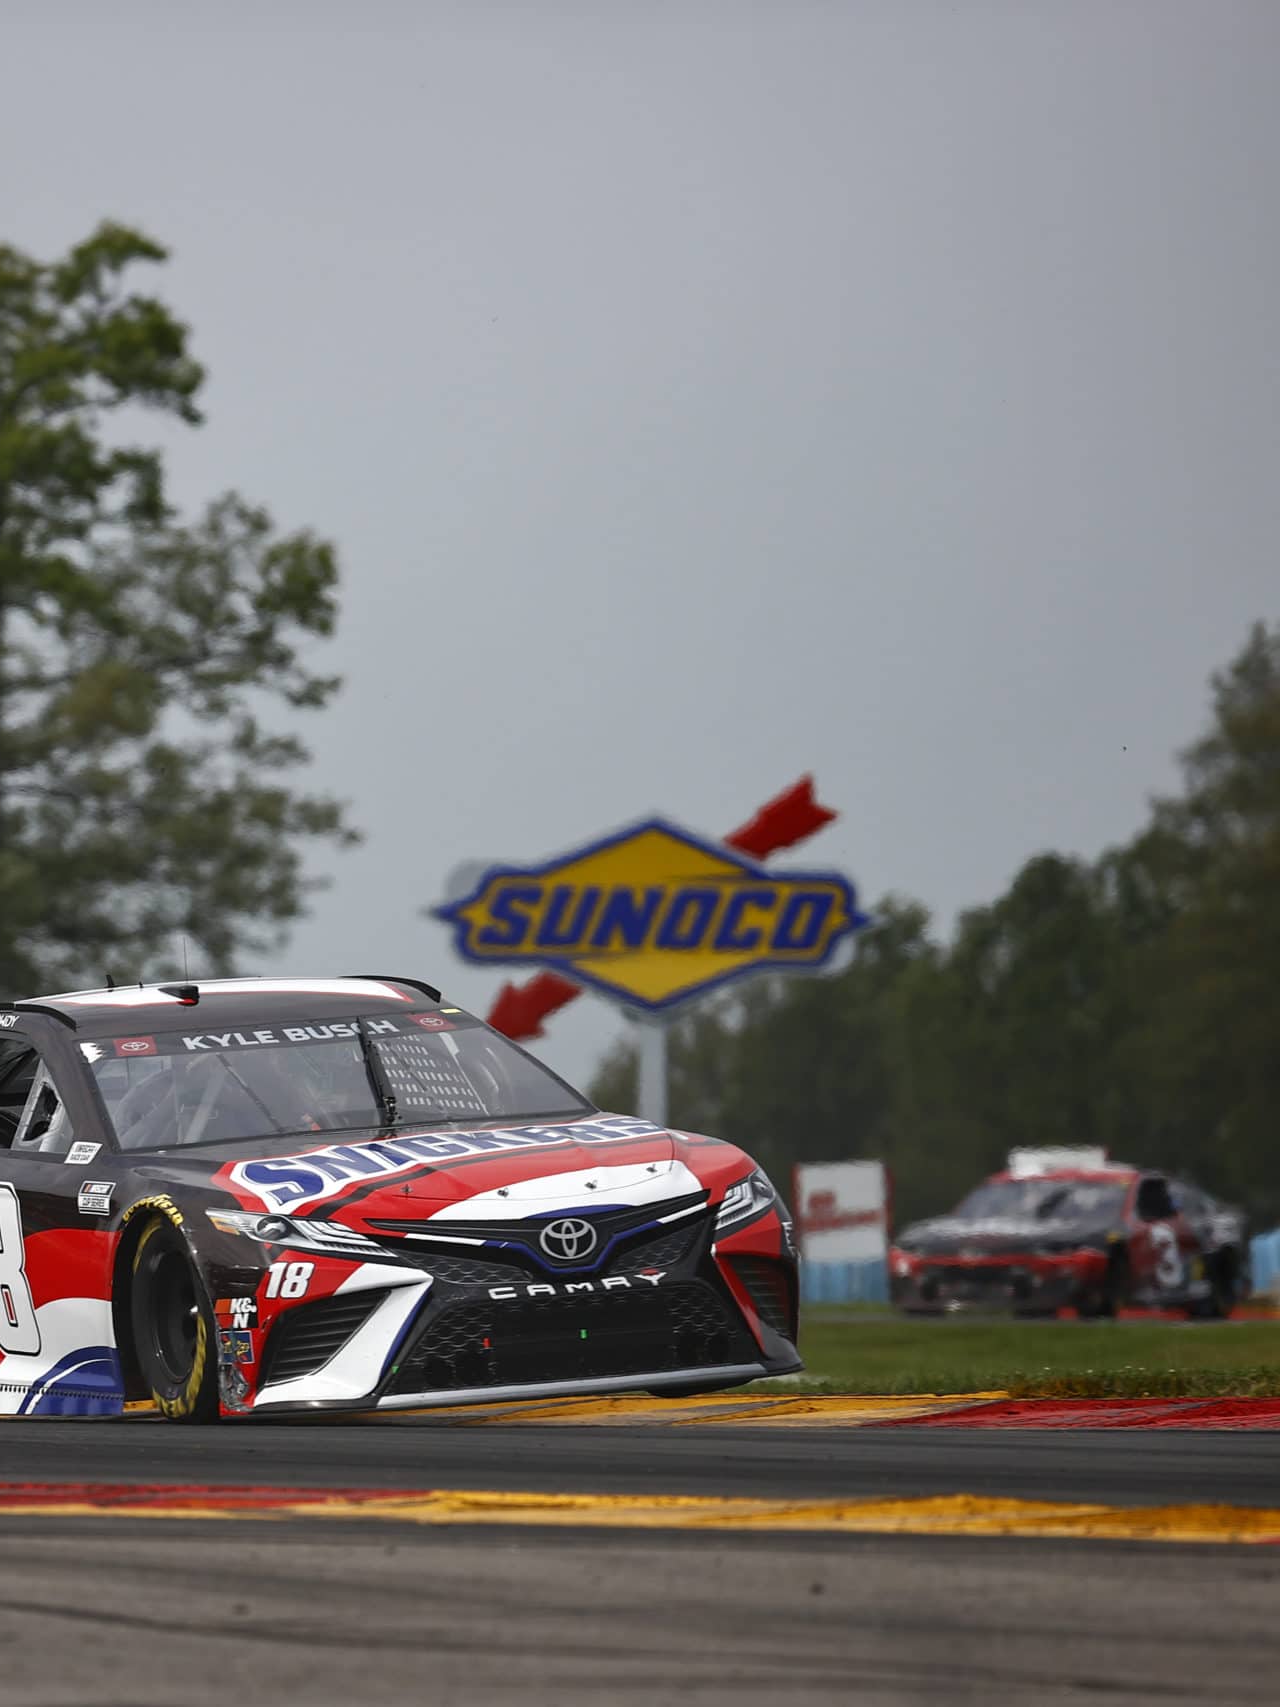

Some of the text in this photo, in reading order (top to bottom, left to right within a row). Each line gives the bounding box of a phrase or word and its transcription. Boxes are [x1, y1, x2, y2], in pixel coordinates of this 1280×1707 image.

[477, 884, 836, 951] SUNOCO
[182, 1029, 281, 1051] KYLE
[242, 1117, 667, 1206] SNICKERS
[265, 1262, 315, 1298] 18
[1150, 1222, 1184, 1289] 3
[488, 1271, 667, 1300] CAMRY
